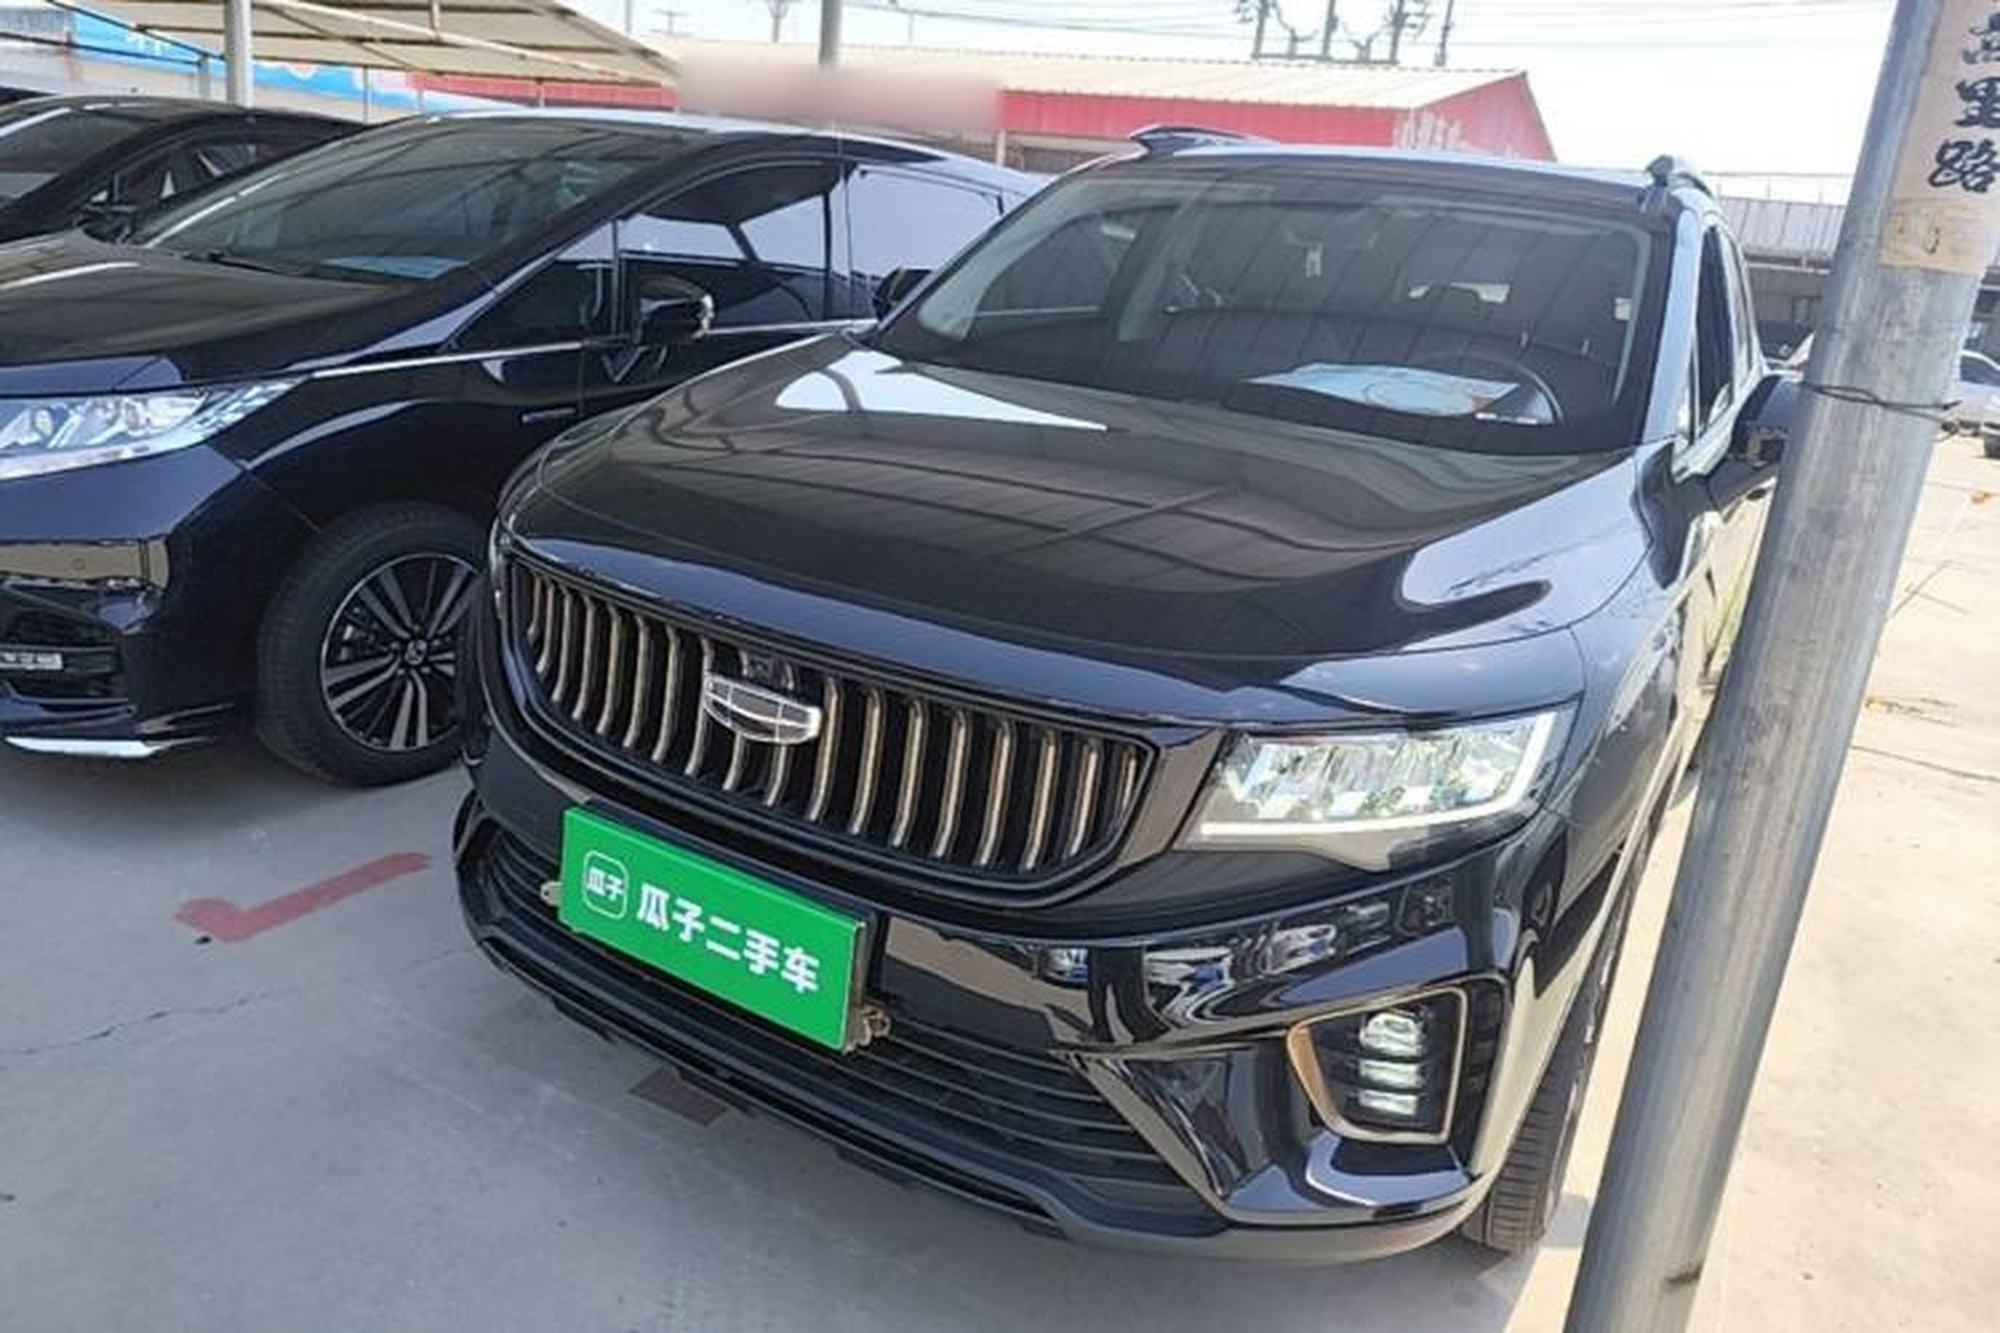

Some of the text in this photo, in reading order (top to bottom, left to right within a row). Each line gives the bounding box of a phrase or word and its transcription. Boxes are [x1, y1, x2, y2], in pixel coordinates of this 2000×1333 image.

[587, 866, 624, 901] 瓜子
[637, 882, 819, 993] 瓜子二手车
